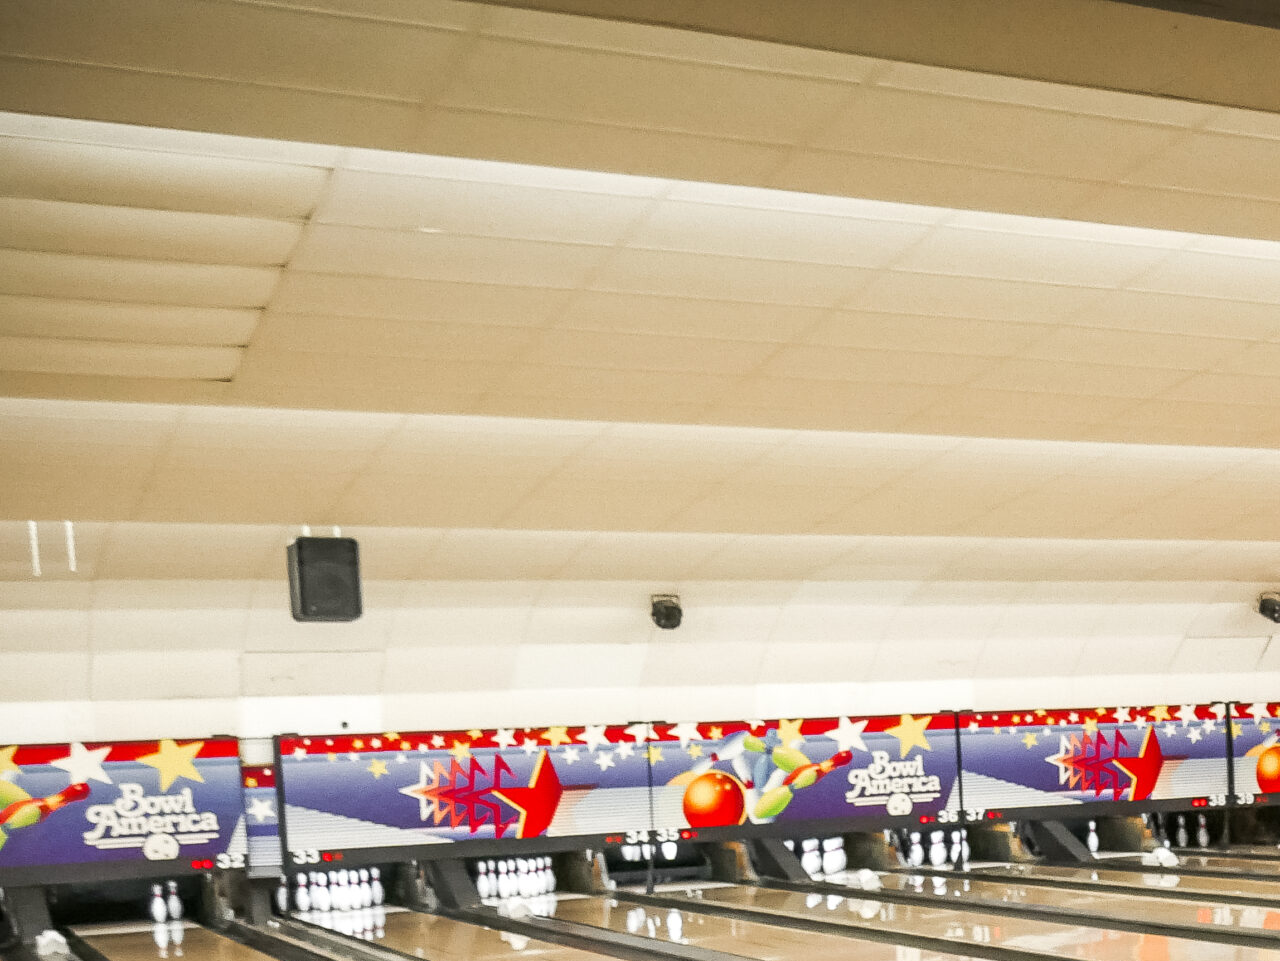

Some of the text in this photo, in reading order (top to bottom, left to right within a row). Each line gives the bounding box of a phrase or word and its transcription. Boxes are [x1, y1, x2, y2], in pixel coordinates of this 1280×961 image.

[867, 750, 926, 780] Bowl
[845, 767, 942, 799] America
[116, 782, 197, 818] Bowl
[966, 807, 985, 822] 37
[83, 804, 221, 841] America
[216, 853, 246, 869] 32
[292, 850, 321, 865] 33
